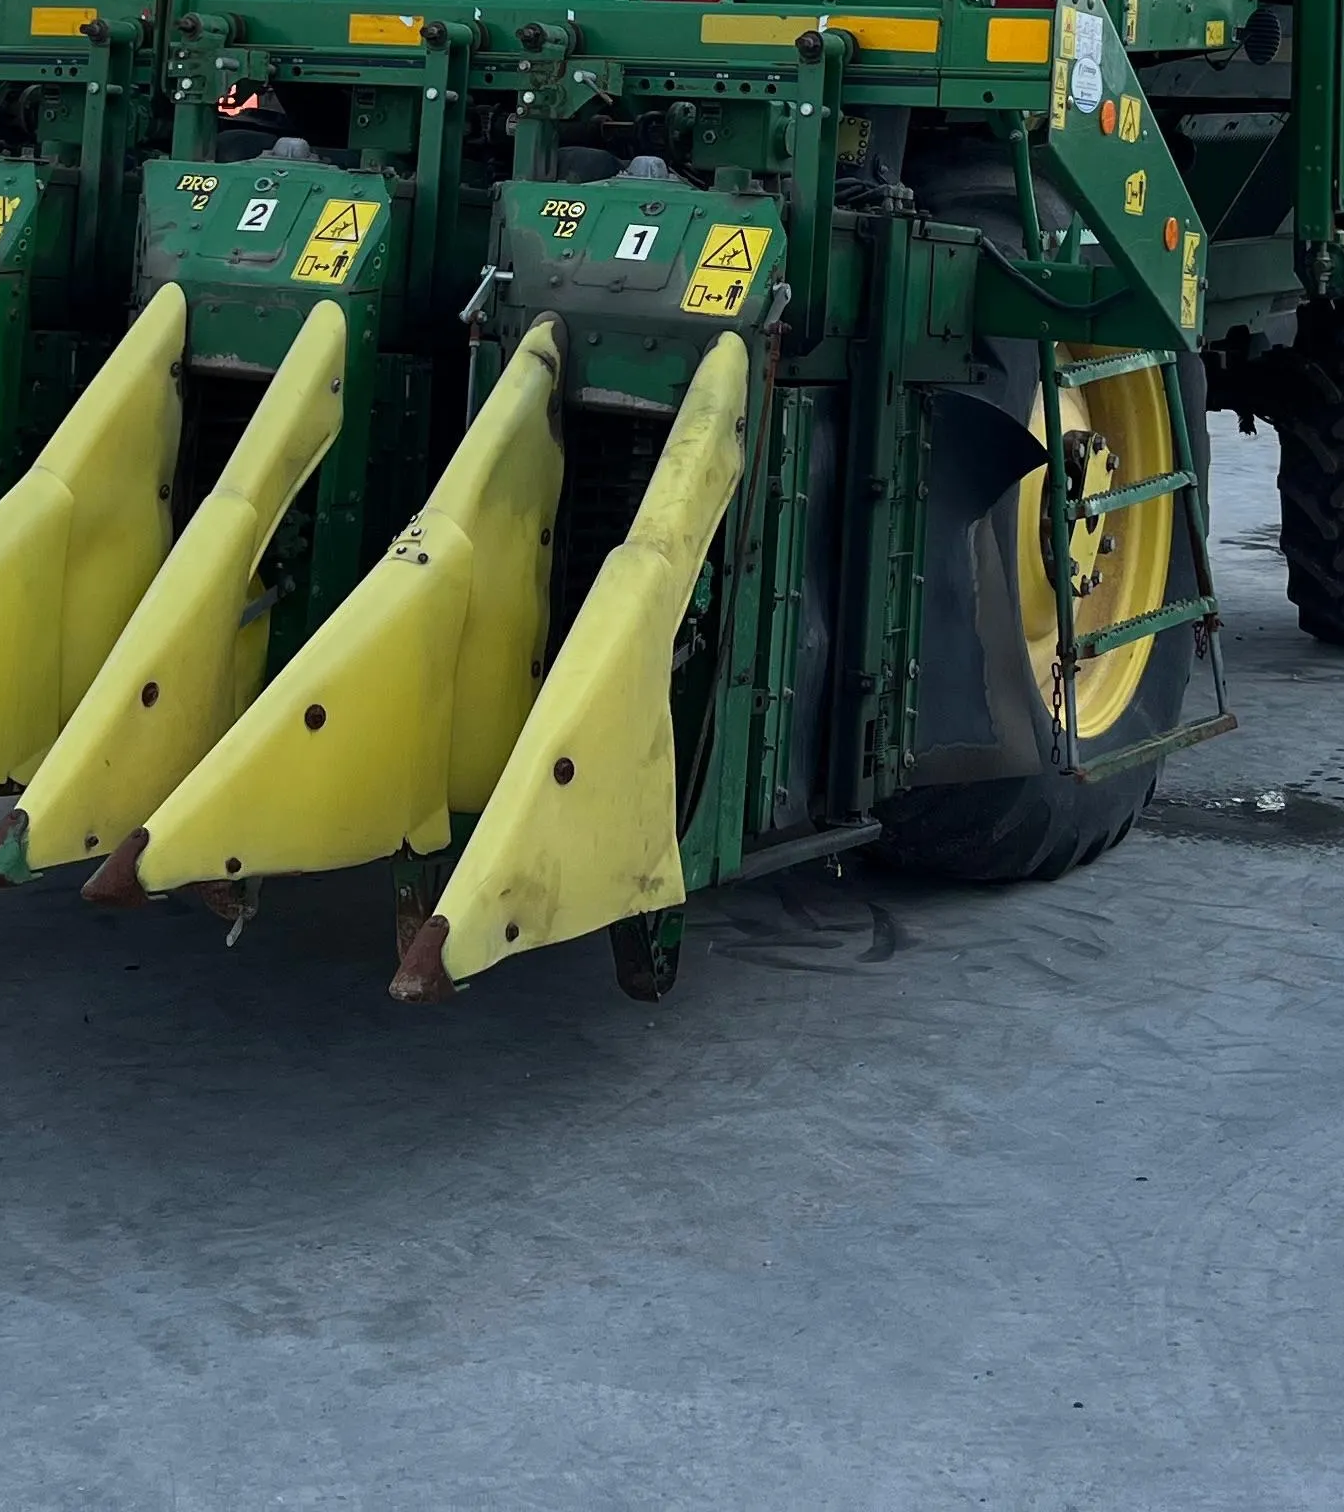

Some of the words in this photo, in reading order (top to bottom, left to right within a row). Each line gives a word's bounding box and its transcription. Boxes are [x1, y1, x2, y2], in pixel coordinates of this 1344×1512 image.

[176, 175, 218, 192] PRO
[244, 203, 269, 226] 2
[539, 199, 586, 218] PRO
[553, 220, 578, 238] 12
[632, 230, 649, 255] 1
